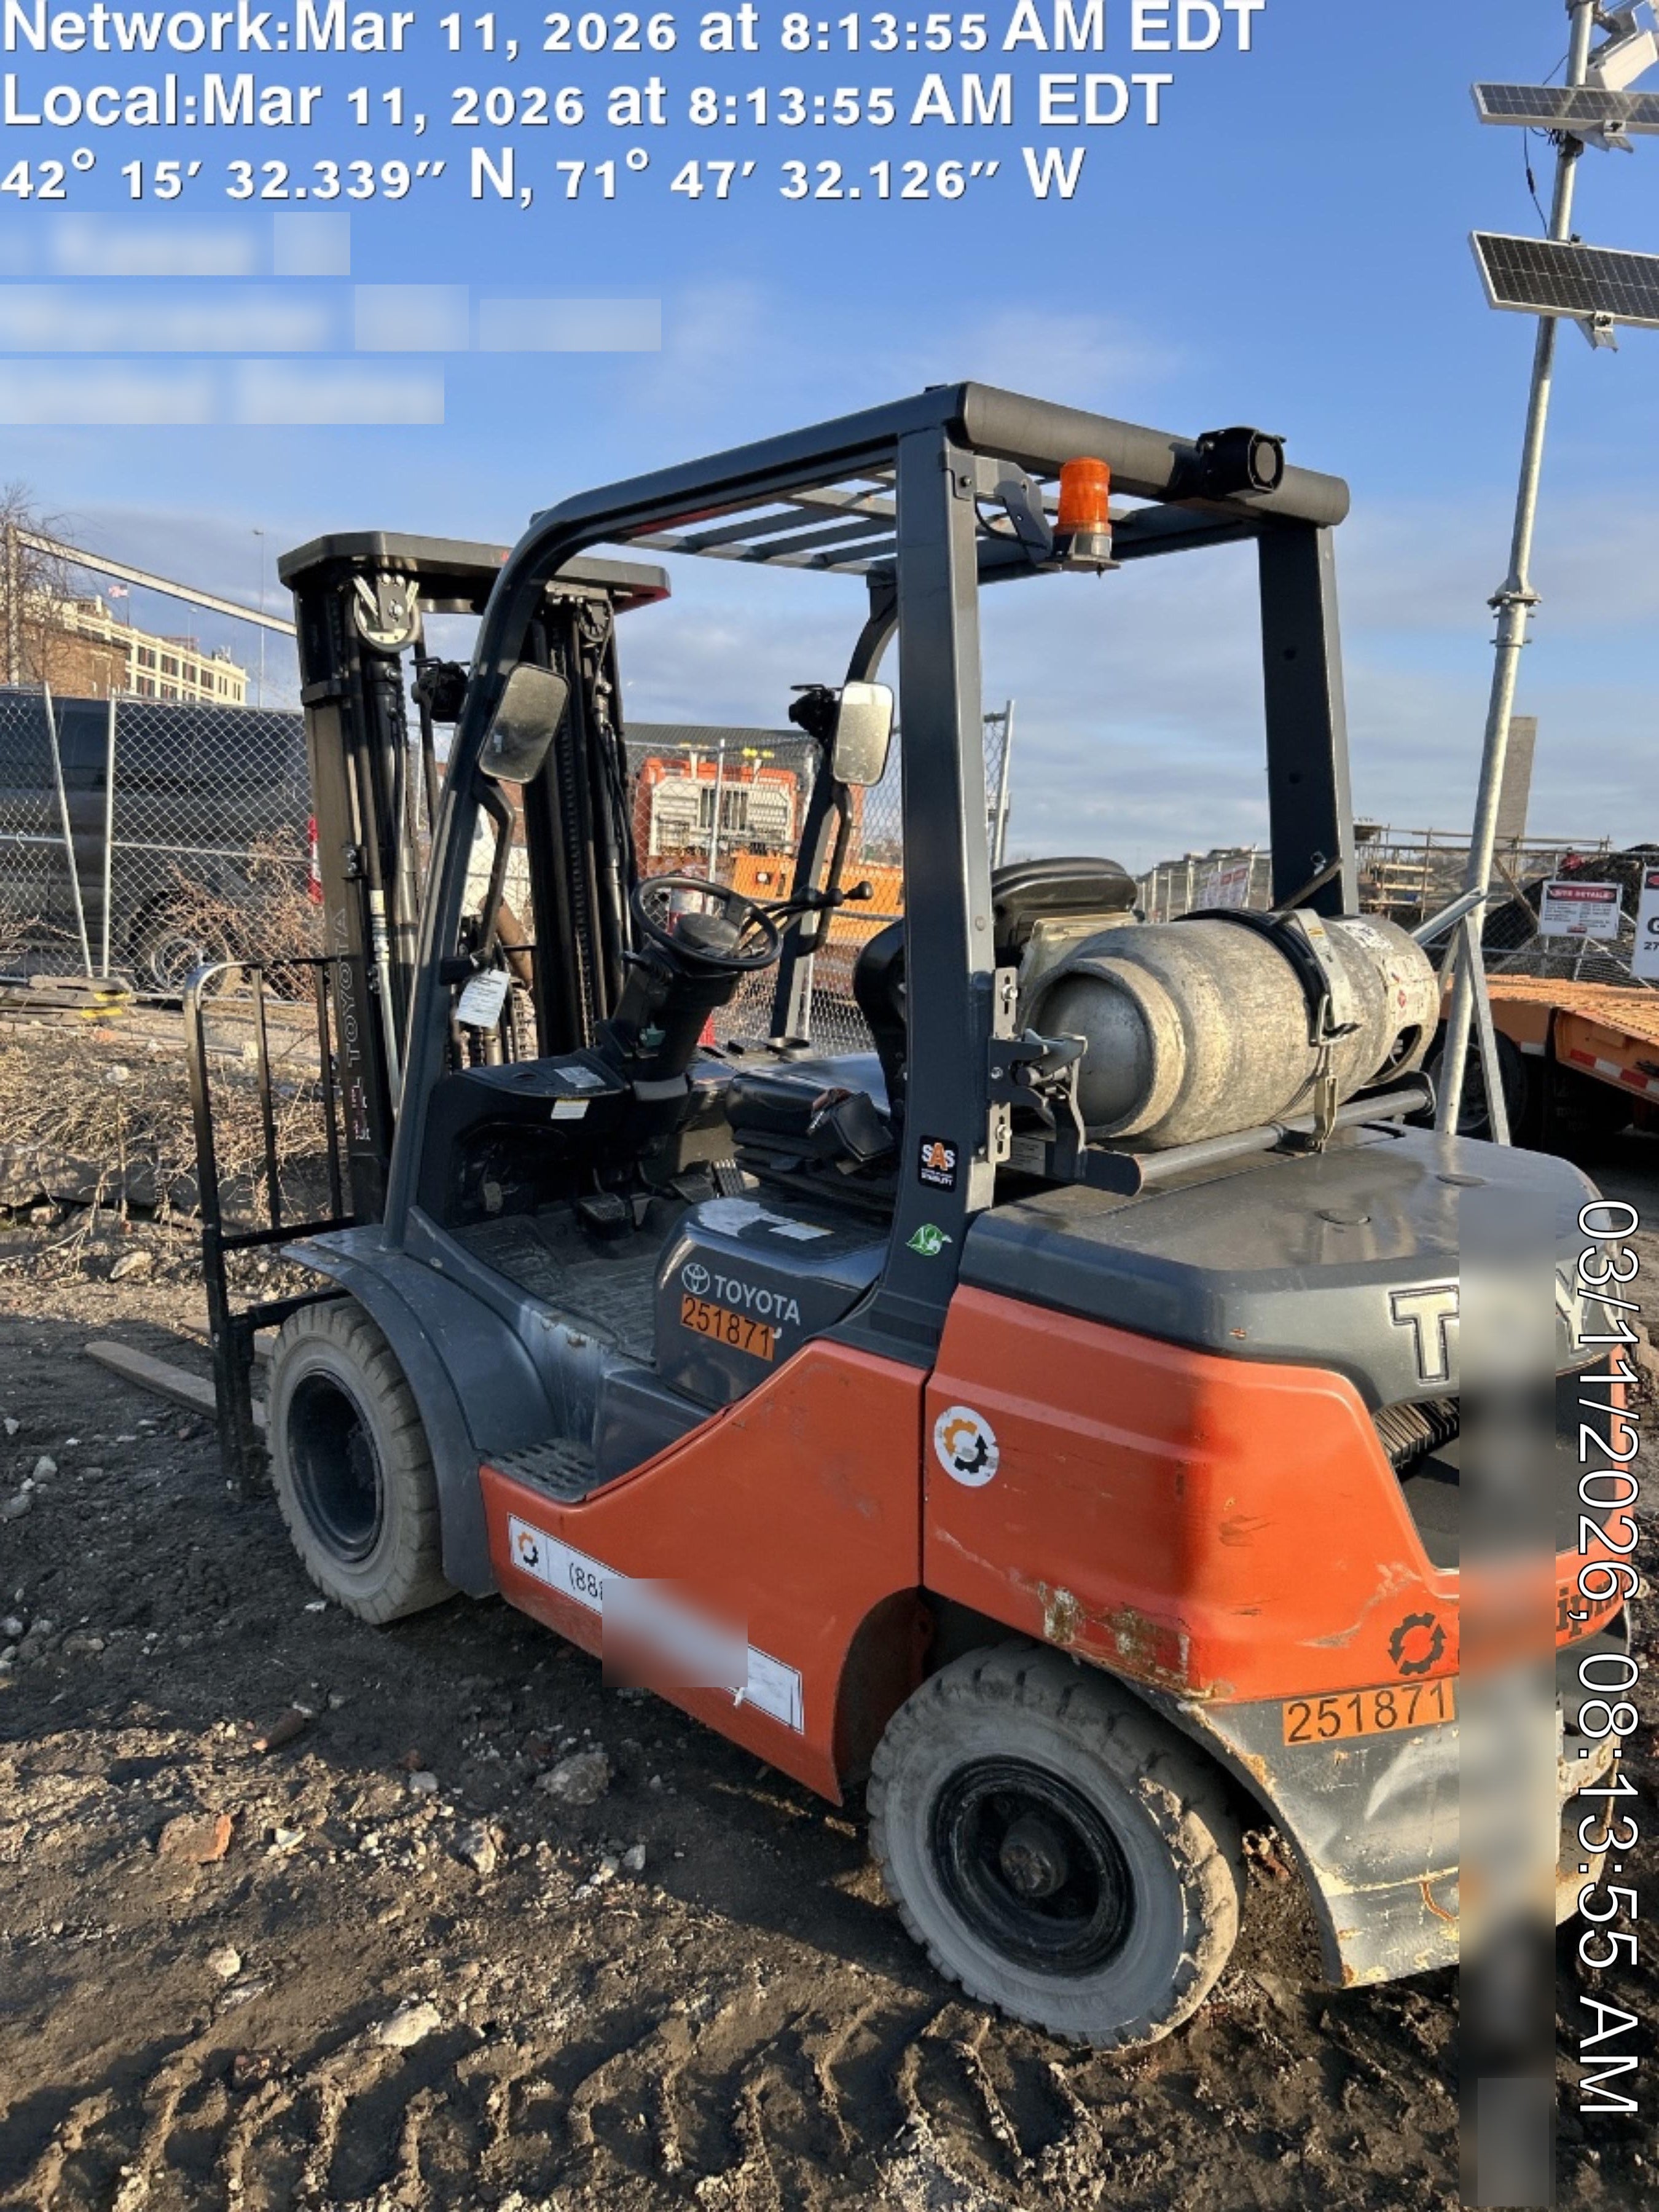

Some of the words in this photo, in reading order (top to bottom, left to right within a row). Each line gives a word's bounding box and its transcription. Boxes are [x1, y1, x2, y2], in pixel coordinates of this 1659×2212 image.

[334, 908, 361, 1069] TOYOTA
[922, 1142, 955, 1171] SAS
[682, 1296, 769, 1357] 251871
[714, 1274, 801, 1326] TOYOTA
[1287, 1680, 1445, 1743] 251871
